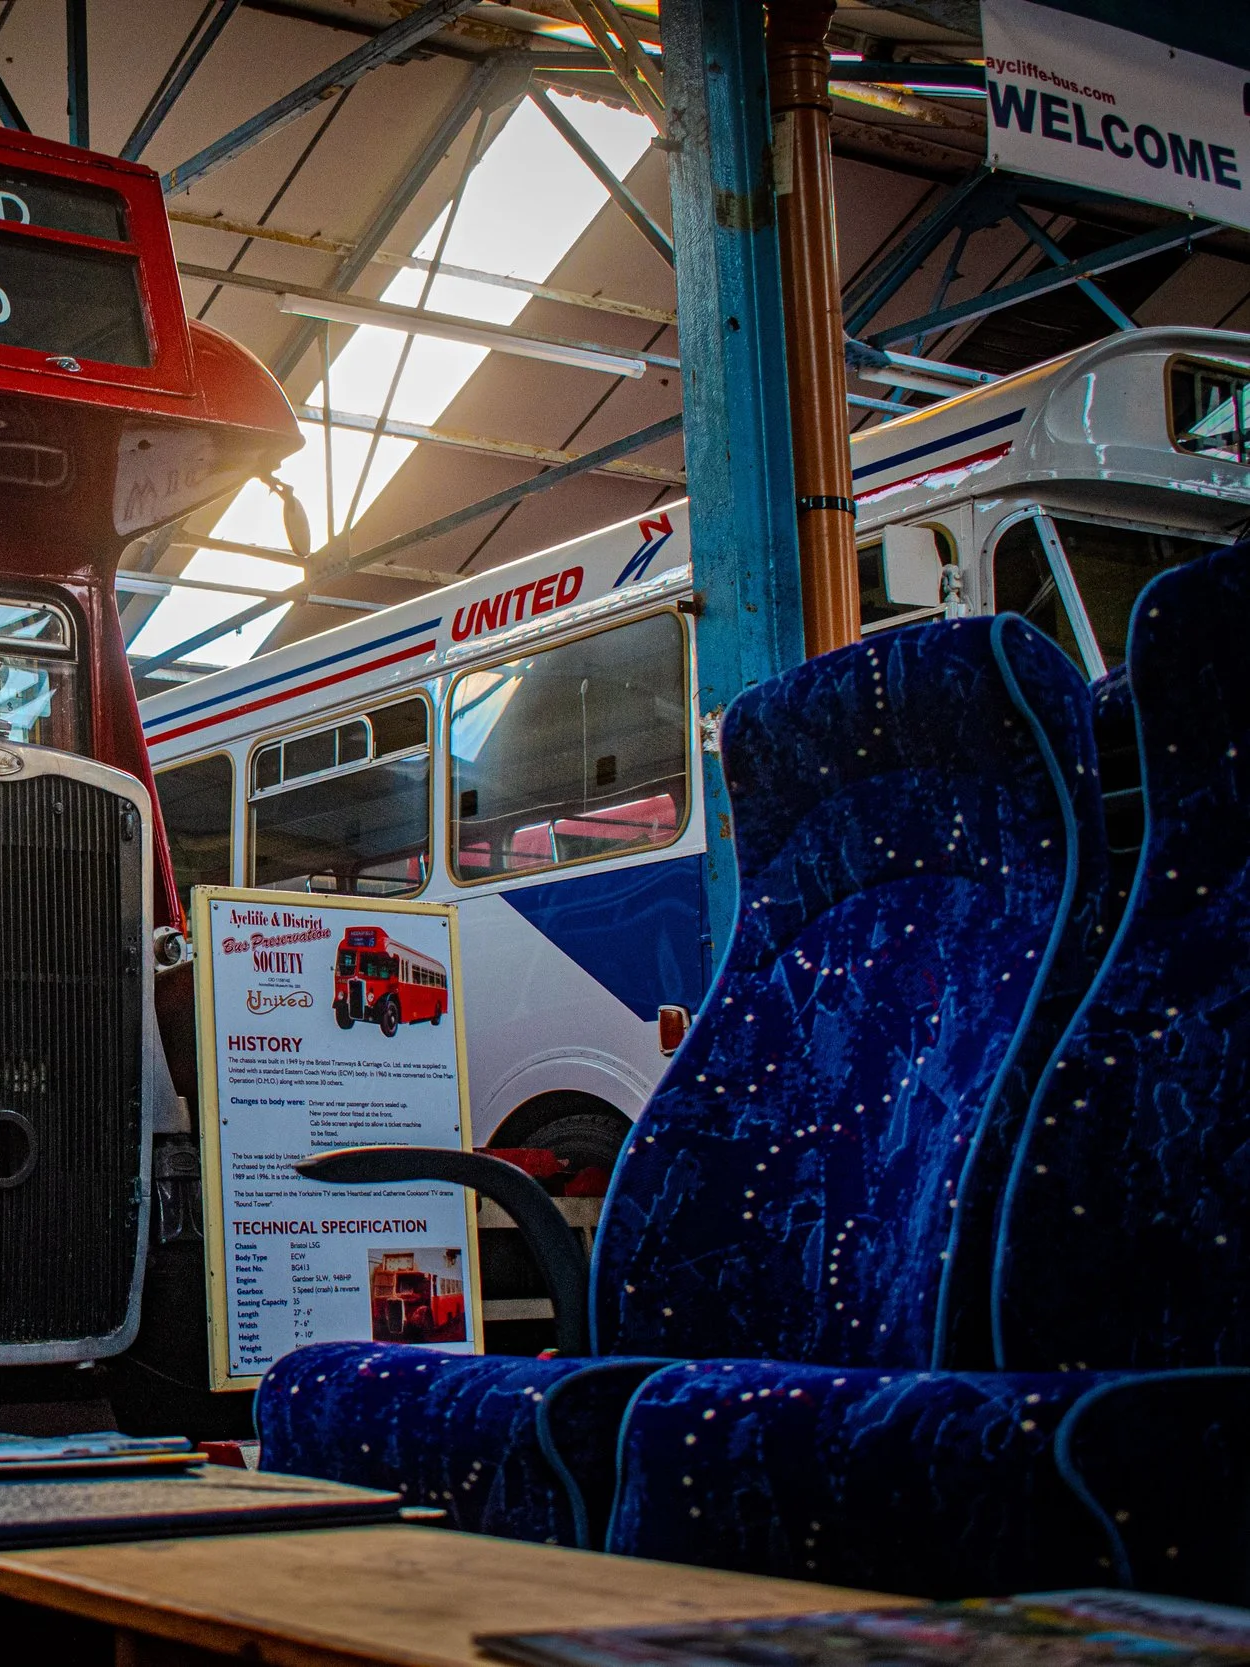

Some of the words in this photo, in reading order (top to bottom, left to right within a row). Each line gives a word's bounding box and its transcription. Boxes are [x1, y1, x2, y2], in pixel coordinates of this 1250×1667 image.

[986, 54, 1116, 106] aycliffe-bus.com
[988, 80, 1242, 190] WELCOME
[451, 565, 584, 642] UNITED
[230, 910, 269, 928] Aycliffe
[271, 912, 280, 926] &
[283, 913, 323, 930] District
[222, 937, 250, 955] Bus
[250, 927, 332, 951] Preservation
[253, 951, 304, 974] SOCIETY
[246, 990, 313, 1014] United
[228, 1036, 303, 1053] HISTORY
[229, 1077, 255, 1086] Operation
[231, 1097, 258, 1106] Changes
[260, 1097, 267, 1105] to
[269, 1097, 285, 1107] body
[232, 1221, 318, 1236] TECHNICAL
[321, 1219, 427, 1234] SPECIFICATION
[290, 1241, 308, 1249] Bristol
[235, 1254, 251, 1262] Body
[252, 1254, 267, 1262] Type
[236, 1276, 257, 1285] Engine
[292, 1275, 314, 1283] Gardner
[297, 1286, 314, 1294] Speed
[237, 1299, 261, 1308] Seating
[261, 1298, 288, 1307] Capacity
[238, 1311, 259, 1319] Length
[238, 1333, 260, 1342] Height
[239, 1345, 262, 1353] Weight
[240, 1356, 252, 1365] Top
[254, 1355, 273, 1365] Speed
